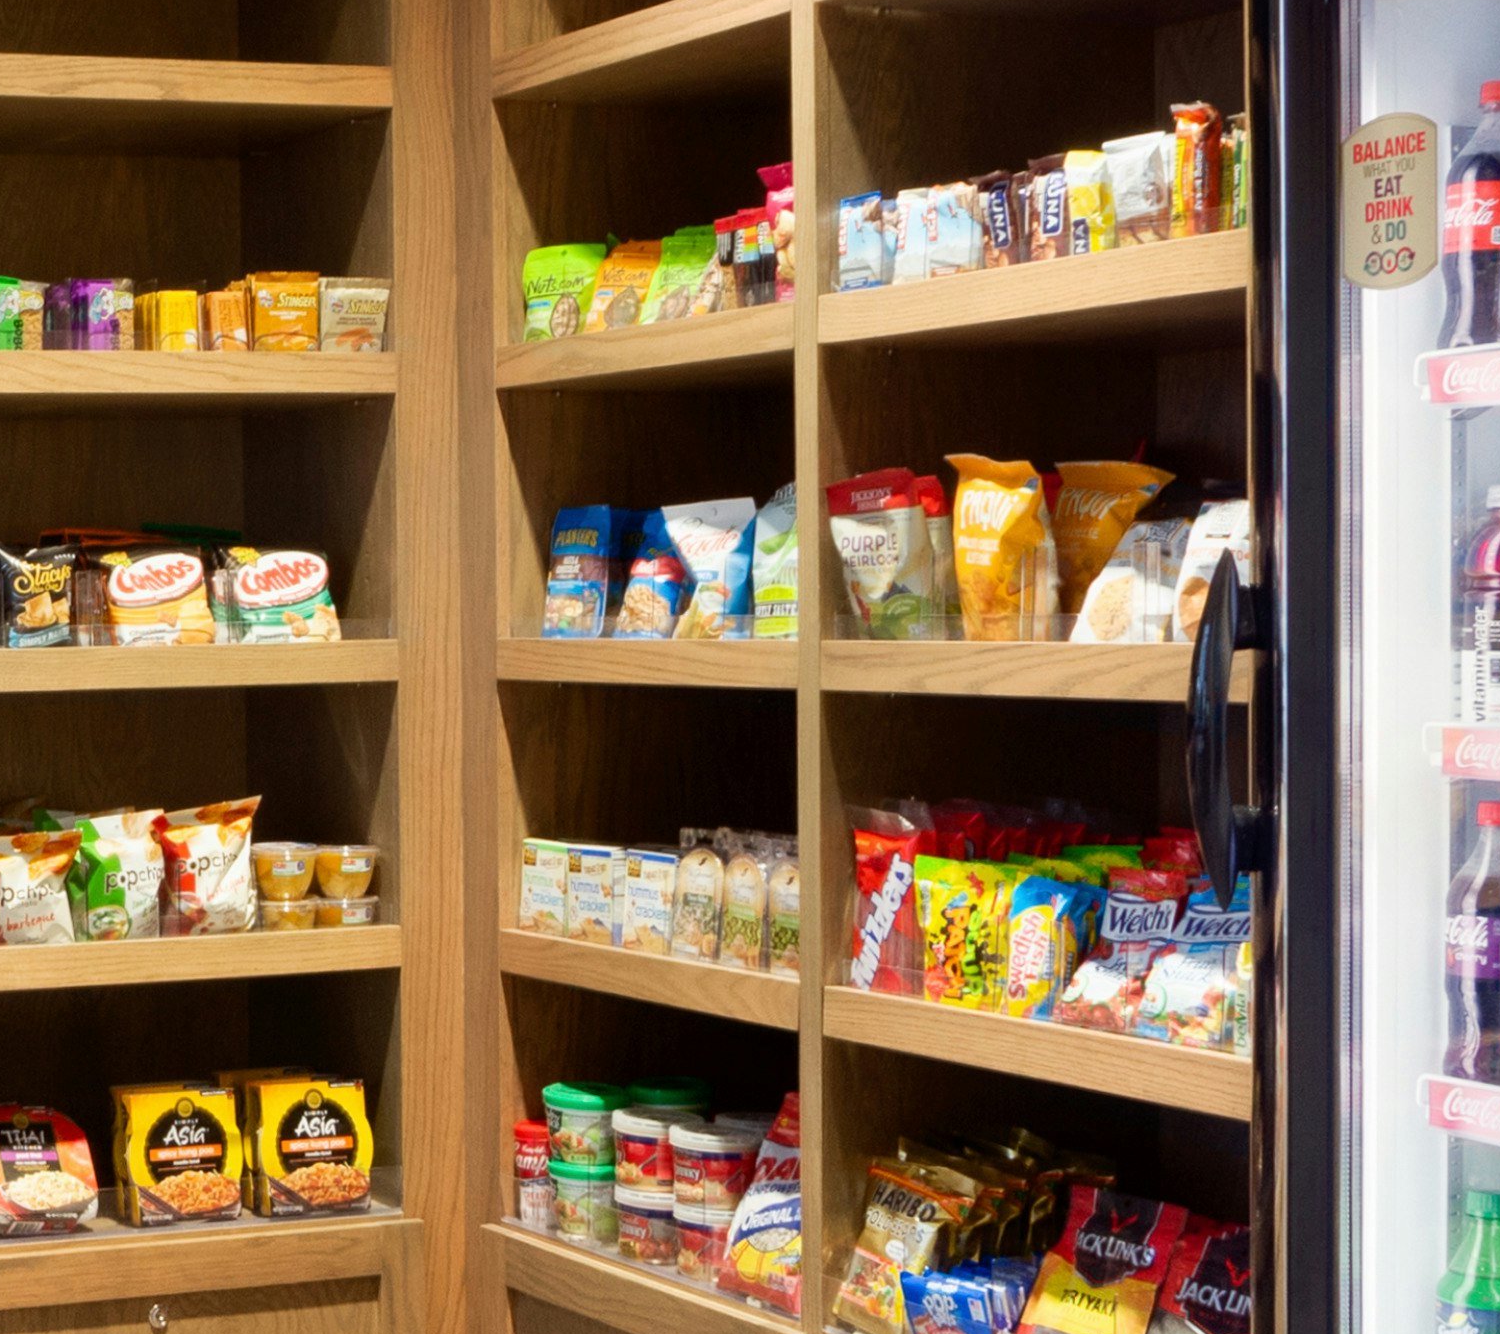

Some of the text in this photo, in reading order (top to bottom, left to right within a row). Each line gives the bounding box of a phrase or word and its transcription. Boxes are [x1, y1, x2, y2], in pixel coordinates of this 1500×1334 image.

[1352, 131, 1427, 164] BALANCE
[1363, 156, 1415, 178] WHAT YOU
[1374, 174, 1403, 198] EAT
[1043, 172, 1065, 235] LUNA
[1365, 196, 1414, 223] DRINK
[1371, 220, 1406, 244] & DO
[525, 276, 585, 296] Nuts.com
[602, 267, 649, 284] Nuts.com
[277, 292, 317, 308] STINGER
[960, 488, 1011, 533] PAQUI
[554, 528, 600, 548] PLANTERS
[841, 535, 899, 555] PURPLE
[842, 553, 899, 568] HEIRLOOM
[13, 560, 73, 594] Stacy's
[115, 556, 196, 594] Combos
[240, 556, 321, 595] Combos
[1472, 606, 1487, 722] vitaminwater
[570, 880, 601, 895] hummus
[628, 885, 659, 901] hummus
[851, 853, 914, 990] Twizzlers
[1110, 900, 1173, 933] Welch's
[1008, 913, 1043, 1000] Swedish
[1024, 935, 1048, 981] Fish
[0, 1129, 45, 1145] THAI
[163, 1125, 206, 1146] Asia
[294, 1116, 337, 1138] Asia
[871, 1181, 937, 1223] HARIBO
[743, 1207, 792, 1231] ORIGINAL
[1076, 1230, 1155, 1267] ACK LINK'S
[1175, 1278, 1251, 1315] JACK LIN
